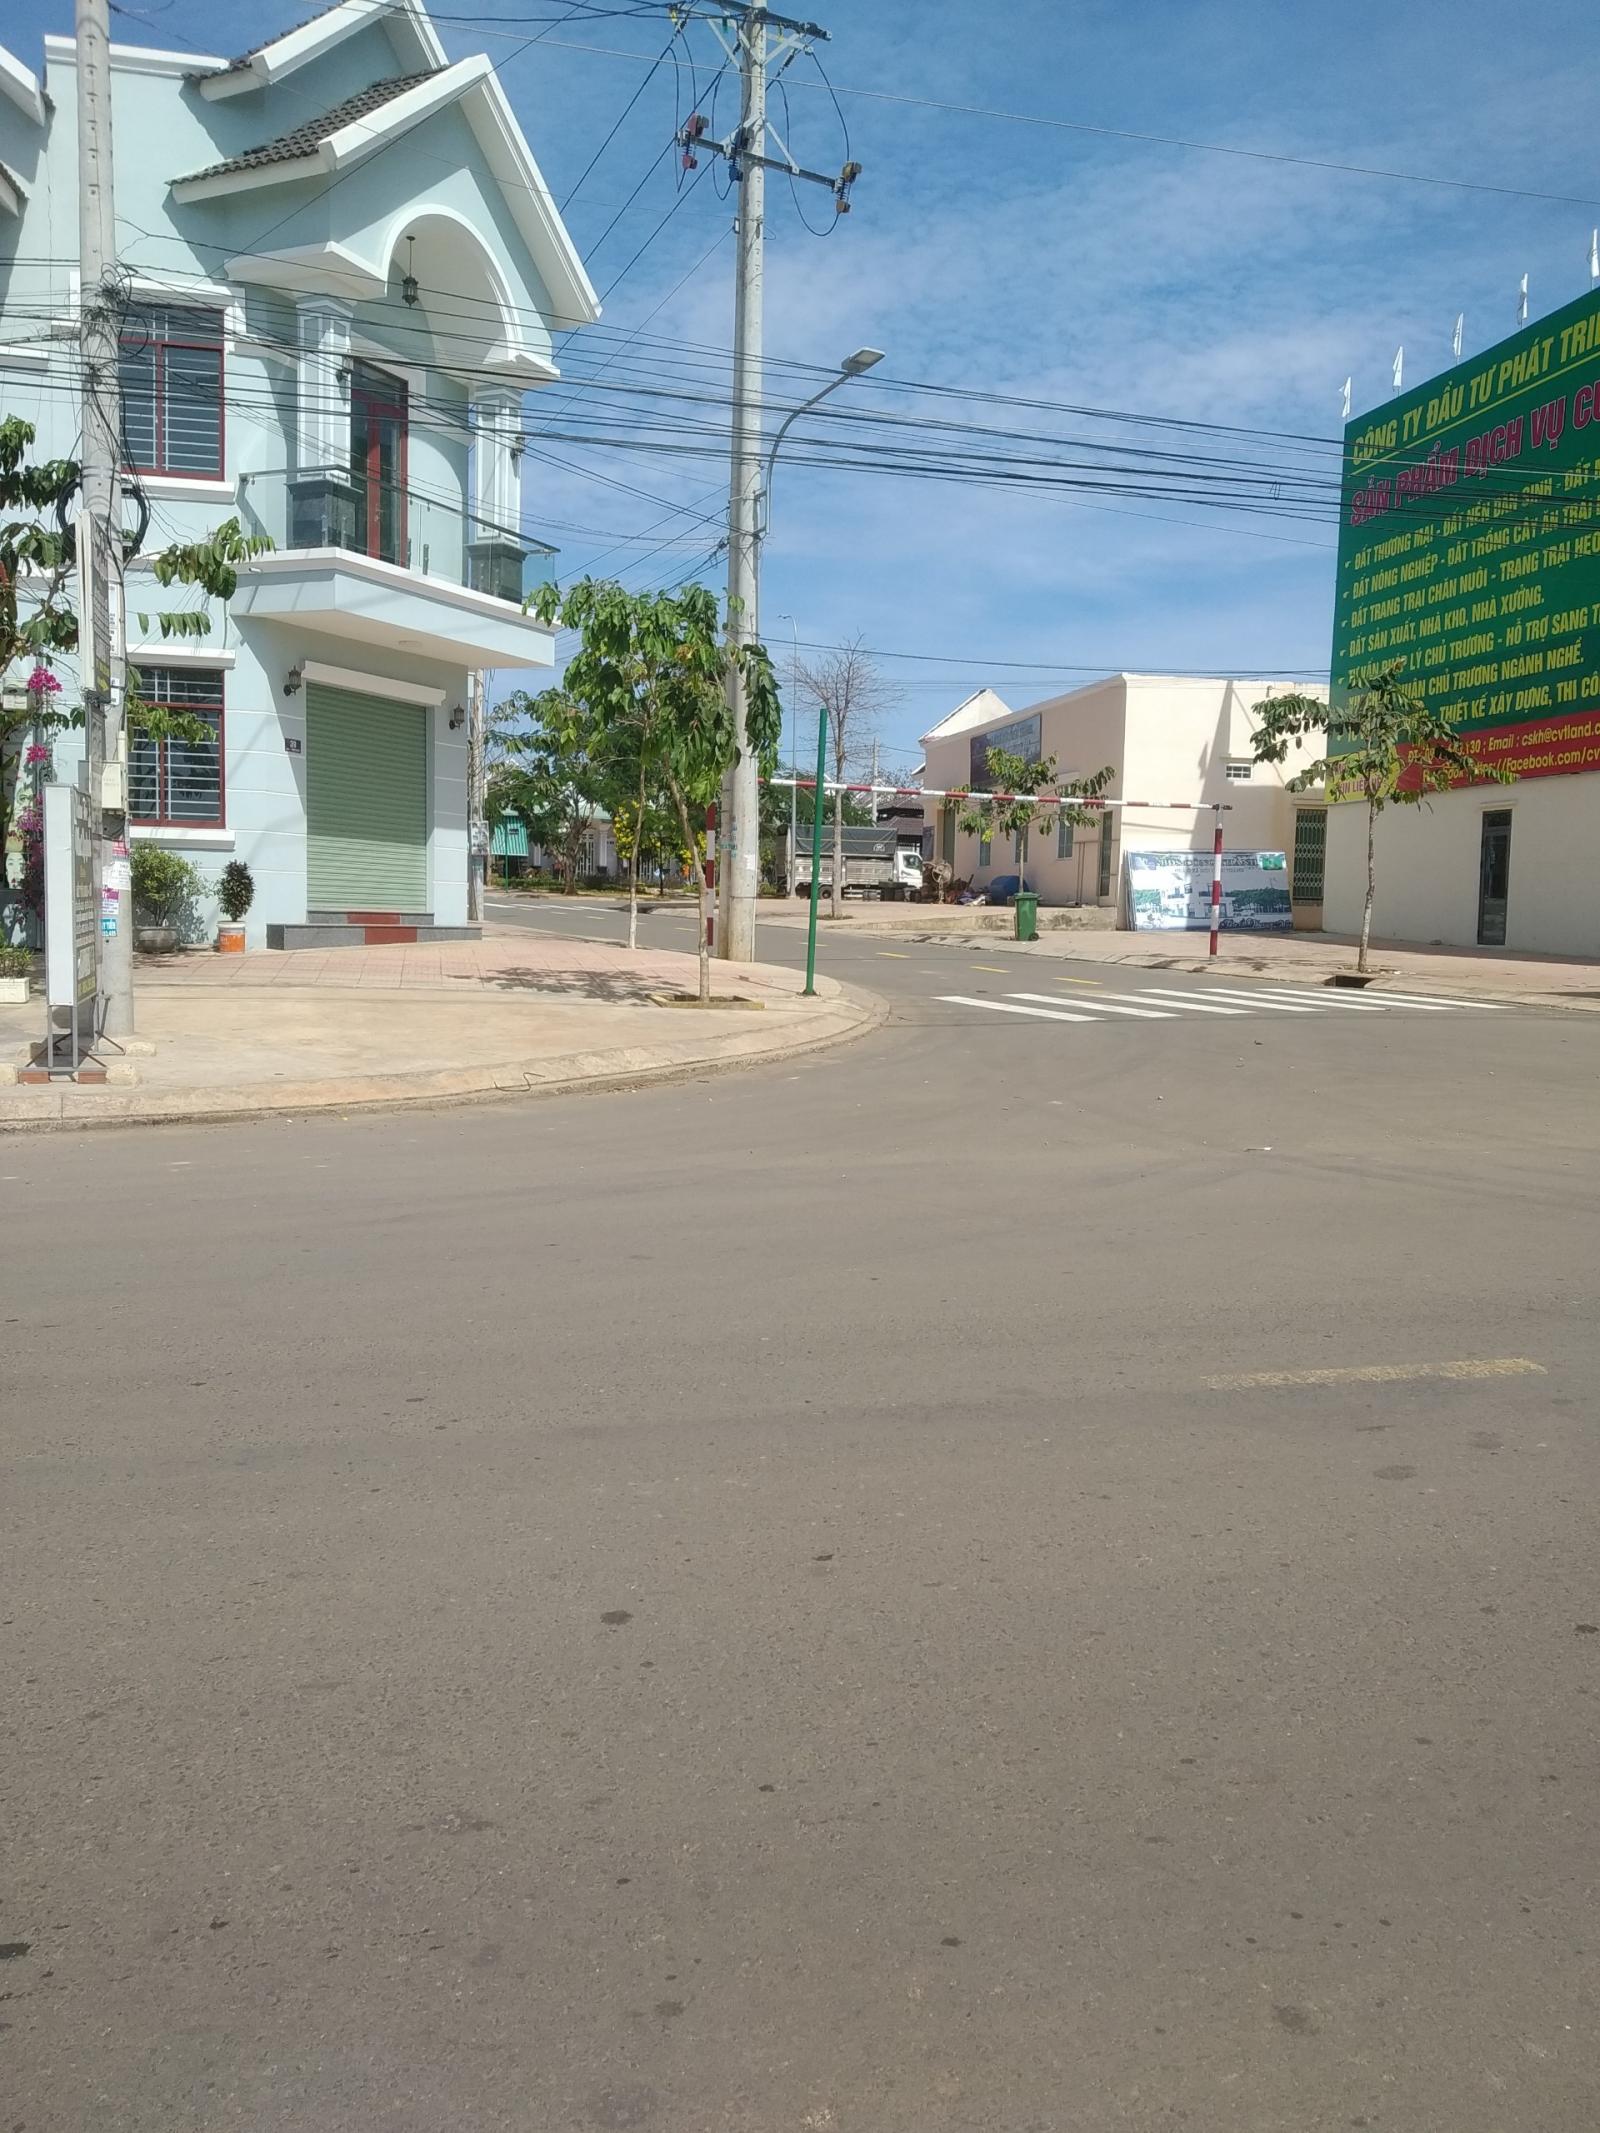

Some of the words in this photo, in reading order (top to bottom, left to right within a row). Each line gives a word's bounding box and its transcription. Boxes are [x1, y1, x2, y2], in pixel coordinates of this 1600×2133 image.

[1353, 419, 1398, 466] CÔNG
[1402, 405, 1424, 441] TY
[1426, 380, 1465, 430] ĐẦU
[1469, 363, 1497, 409] TƯ
[1497, 337, 1555, 395] PHÁT
[1464, 416, 1524, 480] DỊCH
[1530, 395, 1567, 451] VỤ
[1353, 573, 1370, 599] ĐẤT
[1371, 567, 1399, 593] NÔNG
[1401, 552, 1439, 583] NGHIỆP
[1447, 540, 1469, 567] ĐẤT
[1354, 543, 1371, 570] ĐẤT
[1374, 533, 1412, 563] THƯƠNG
[1351, 603, 1368, 629] ĐẤT
[1370, 597, 1400, 622] TRANG
[1403, 588, 1426, 612] TRẠI
[1428, 577, 1457, 604] CHĂN
[1459, 566, 1488, 594] NUÔI
[1500, 552, 1539, 582] TRANG
[1543, 541, 1570, 568] TRẠI
[1349, 633, 1366, 657] ĐẤT
[1368, 627, 1388, 652] SẢN
[1419, 612, 1441, 637] NHÀ
[1471, 594, 1497, 623] NHÀ
[1410, 647, 1422, 671] LÝ
[1424, 639, 1447, 667] CHỦ
[1449, 631, 1495, 661] TRƯƠNG
[1506, 618, 1522, 648] HỖ
[1526, 614, 1549, 642] TRỢ
[1551, 606, 1588, 635] SANG
[1428, 668, 1450, 696] CHỦ
[1452, 663, 1498, 690] TRƯƠNG
[1501, 653, 1543, 681] NGÀNH
[1440, 697, 1469, 723] THIẾT
[1471, 692, 1488, 719] KẾ
[1488, 690, 1513, 716] XÂY
[1557, 679, 1577, 703] THI
[1488, 733, 1515, 752] Email
